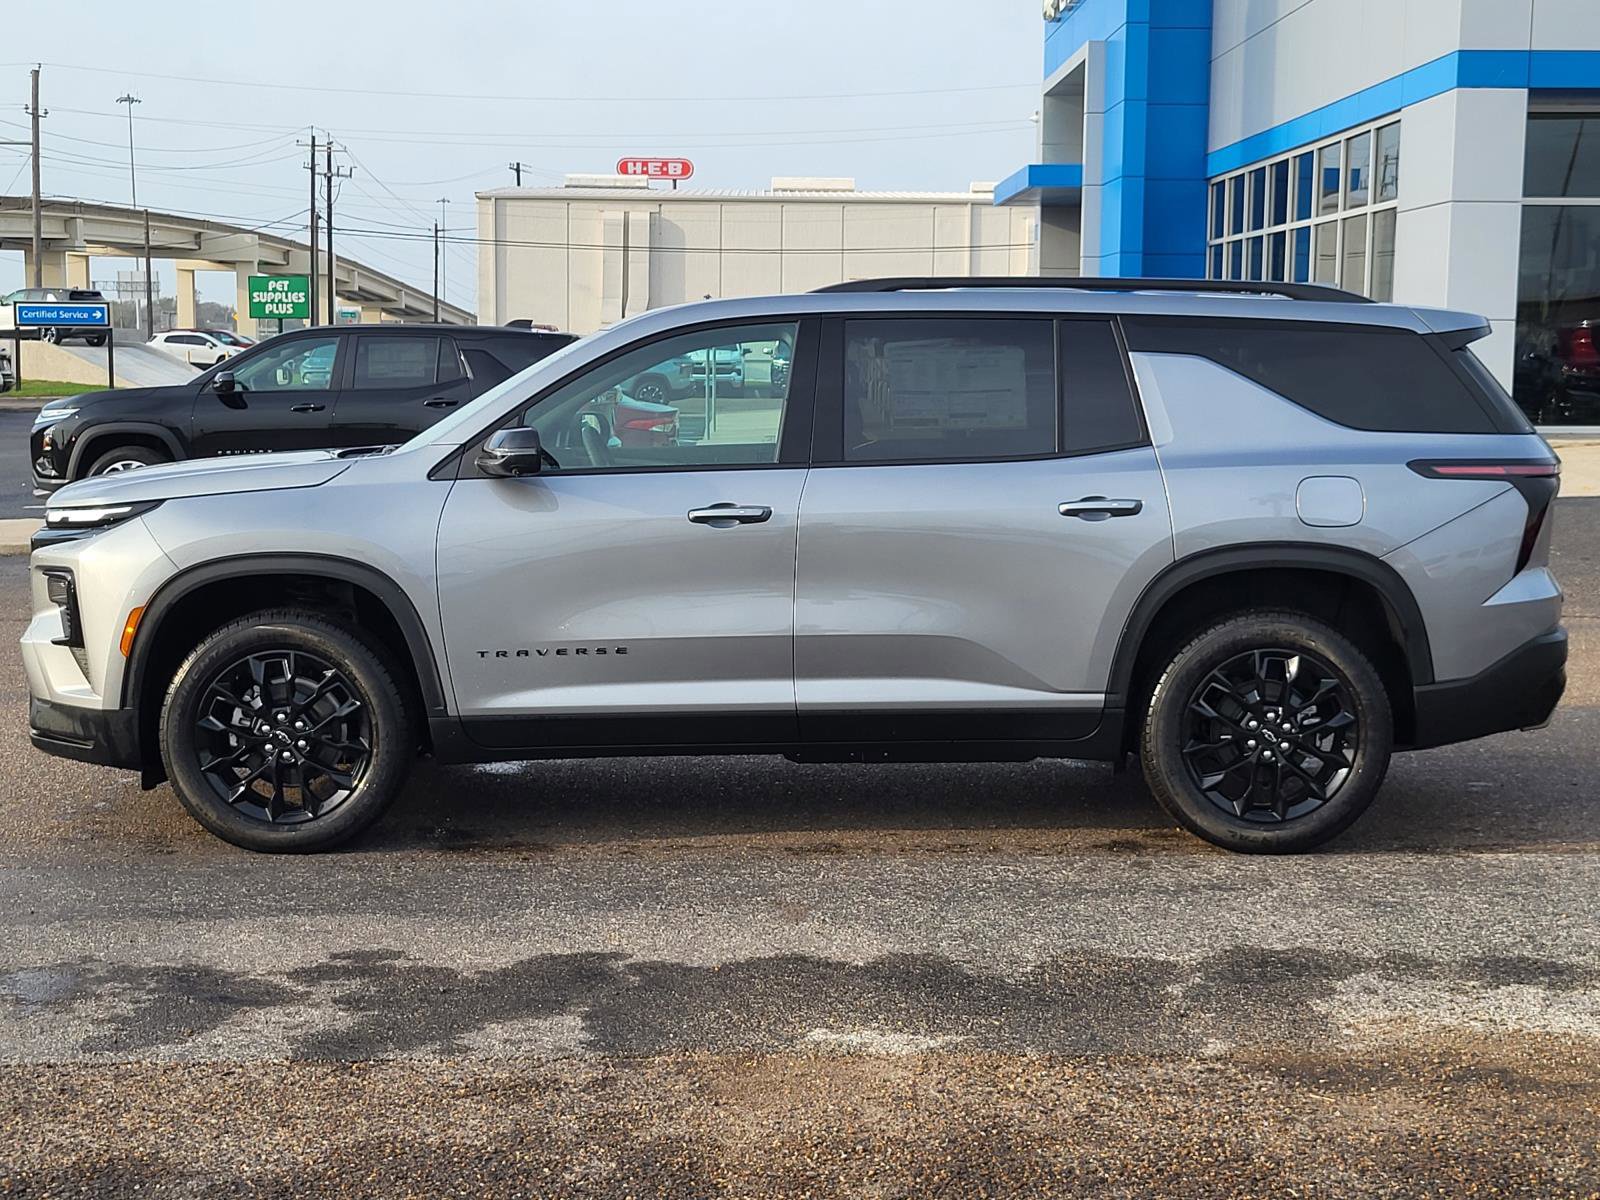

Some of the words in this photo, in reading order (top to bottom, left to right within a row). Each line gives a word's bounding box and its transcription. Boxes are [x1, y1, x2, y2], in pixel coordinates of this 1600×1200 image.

[268, 280, 289, 291] PET
[252, 291, 306, 303] SUPPLIES
[265, 303, 294, 314] PLUS
[22, 310, 57, 318] Certified
[59, 310, 88, 319] Service
[476, 647, 629, 658] TRAVERSE
